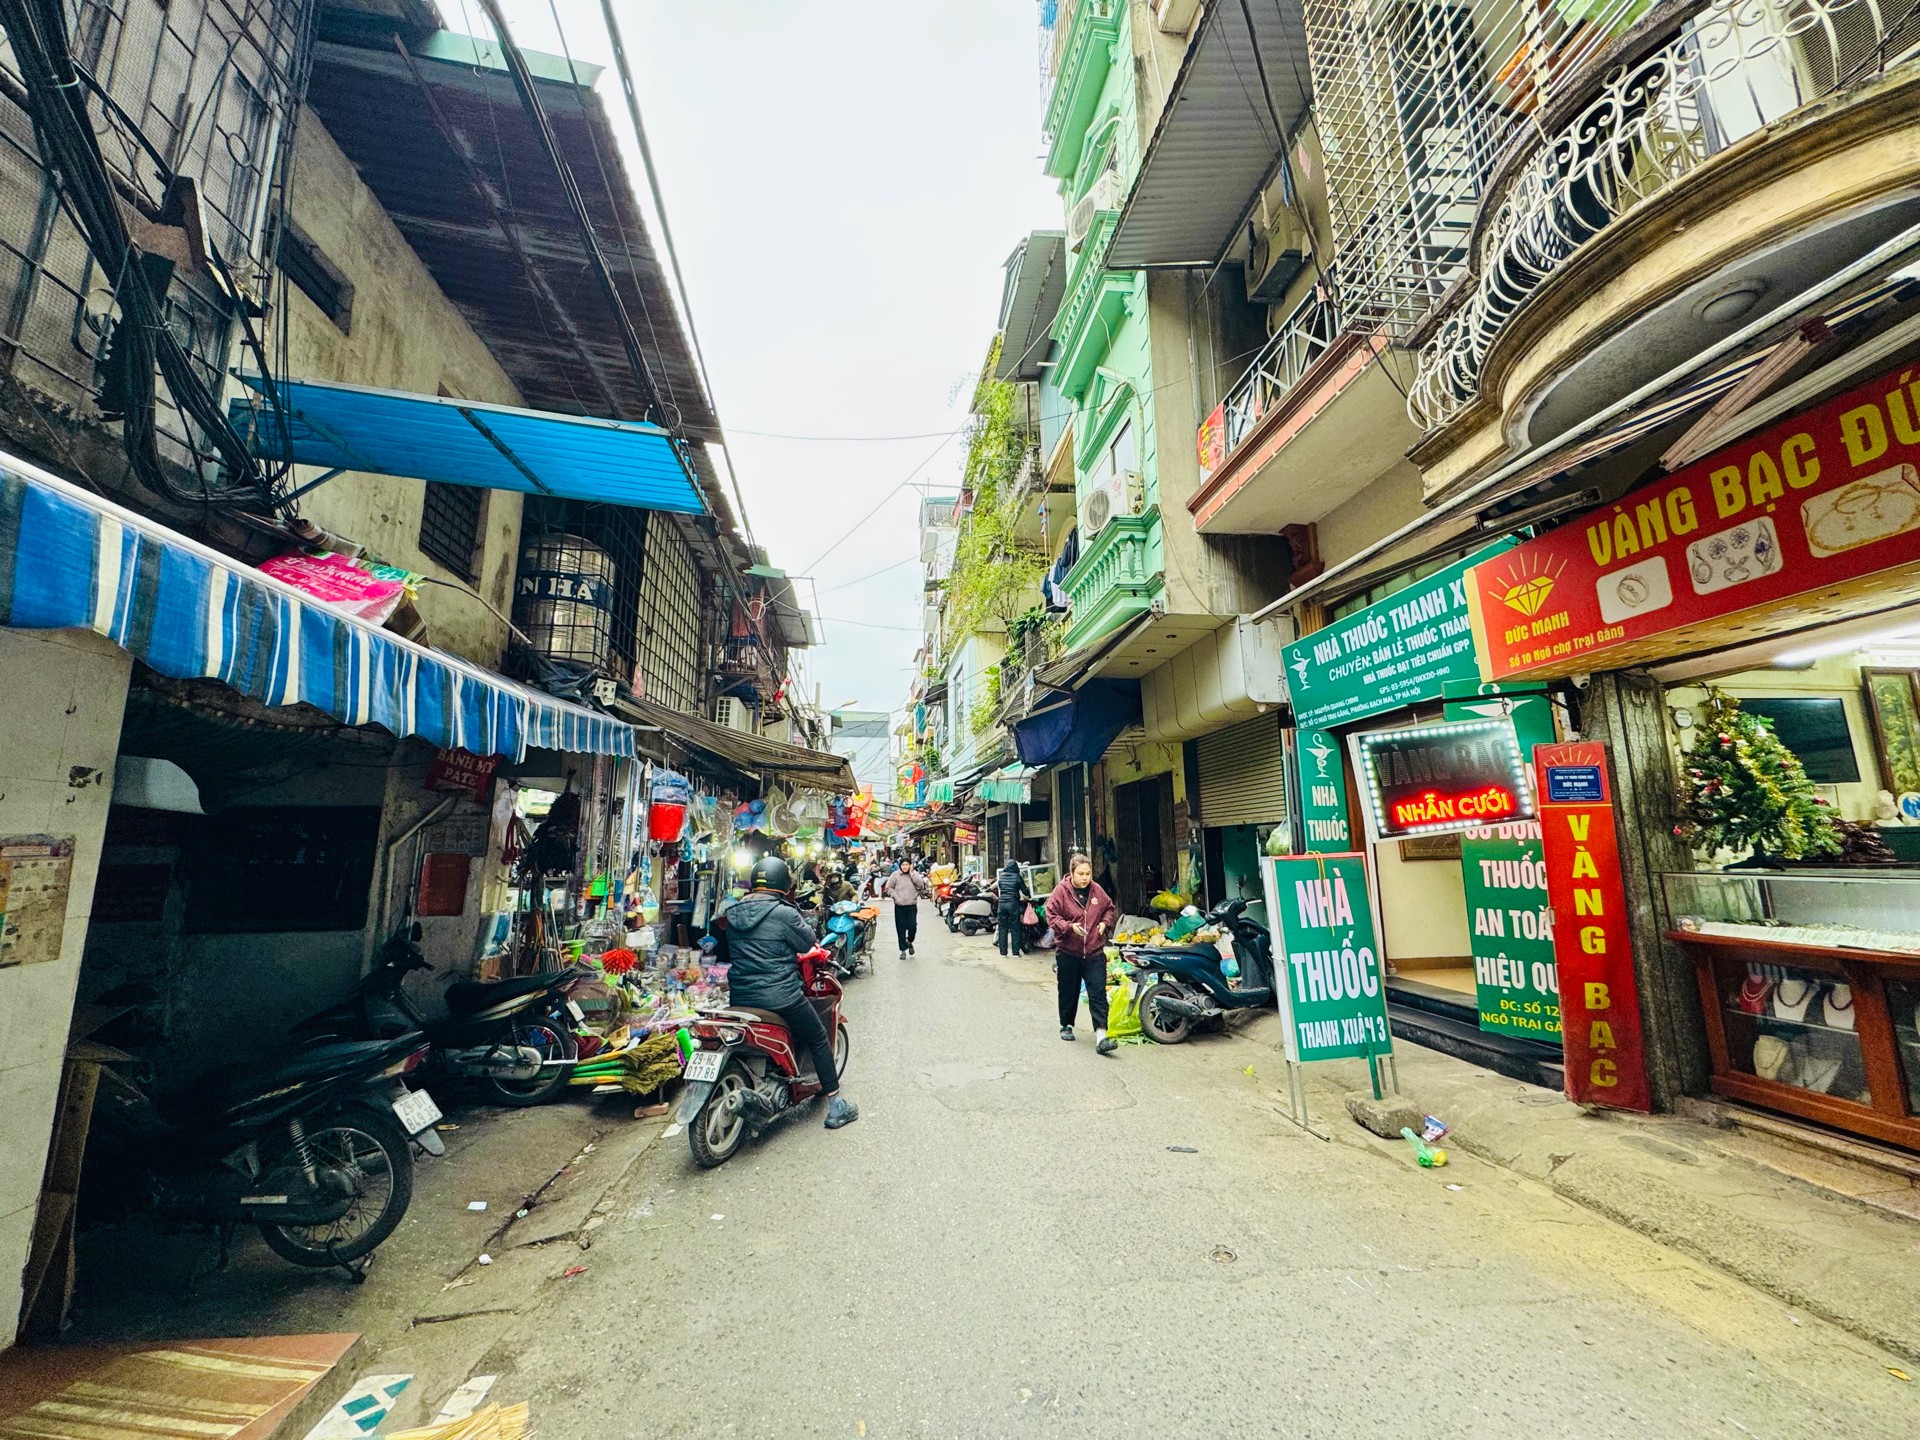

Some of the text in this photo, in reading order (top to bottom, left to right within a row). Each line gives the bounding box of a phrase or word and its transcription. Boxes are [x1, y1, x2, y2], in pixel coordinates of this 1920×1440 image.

[1587, 369, 1920, 567] VÀNG BẠC ĐỨ
[1313, 633, 1342, 666] NHÀ
[1341, 610, 1389, 654] THUỐC
[1388, 587, 1448, 634] THANH
[1504, 611, 1570, 645] ĐỨC MẠNH
[1328, 615, 1471, 681] CHUYÊN: BÁN LẺ THUỐC THÀN
[1363, 672, 1376, 685] NHÀ
[1376, 662, 1397, 680] THUỐC
[1396, 660, 1410, 674] ĐẠT
[1426, 642, 1453, 663] CHUẨN
[1452, 638, 1470, 654] GPP
[1521, 652, 1532, 665] 10
[1533, 645, 1551, 661] Ngõ
[1553, 640, 1572, 655] chợ
[1372, 743, 1451, 787] VÀNG
[1311, 781, 1338, 807] NHÀ
[1396, 788, 1510, 823] NHẪN CƯỚI
[1307, 812, 1348, 841] THUỐC
[1479, 850, 1548, 890] THUỐC
[1567, 815, 1607, 954] VÀNG
[1295, 867, 1354, 929] NHÀ
[1475, 905, 1554, 941] AN TOÀ
[1290, 930, 1378, 1003] THUỐC
[1475, 952, 1559, 995] HIỆU QU
[1481, 1012, 1509, 1025] NGÕ
[1511, 1016, 1542, 1031] TRẠI
[1523, 1001, 1541, 1014] SỐ
[1298, 1020, 1340, 1049] THANH
[1376, 1016, 1386, 1042] 3
[1584, 982, 1618, 1088] BẠC
